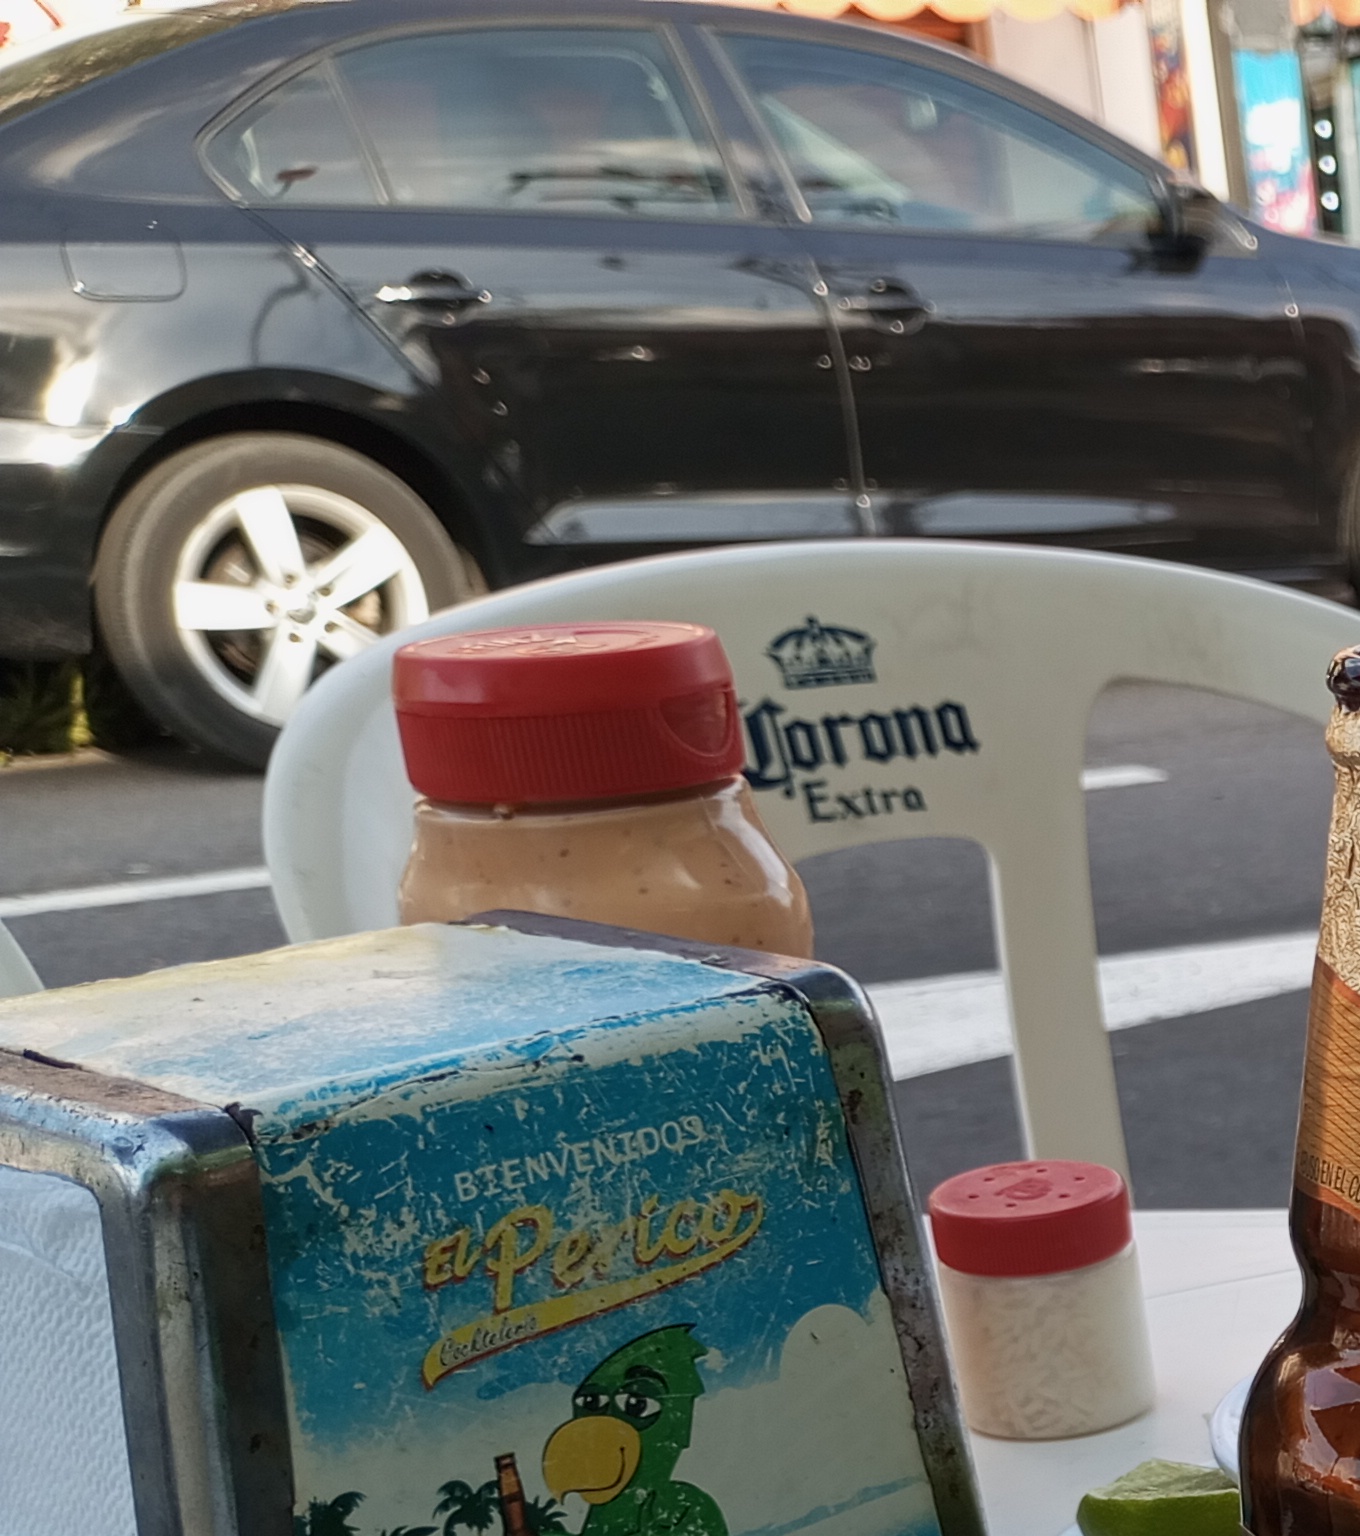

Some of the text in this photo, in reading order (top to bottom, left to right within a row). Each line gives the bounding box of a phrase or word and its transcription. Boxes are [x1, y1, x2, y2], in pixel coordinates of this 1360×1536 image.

[740, 698, 980, 797] Corona
[802, 779, 927, 823] Extra
[454, 1114, 707, 1201] BIENVENIDOS
[1335, 1165, 1347, 1194] EL
[484, 1188, 764, 1315] Perico
